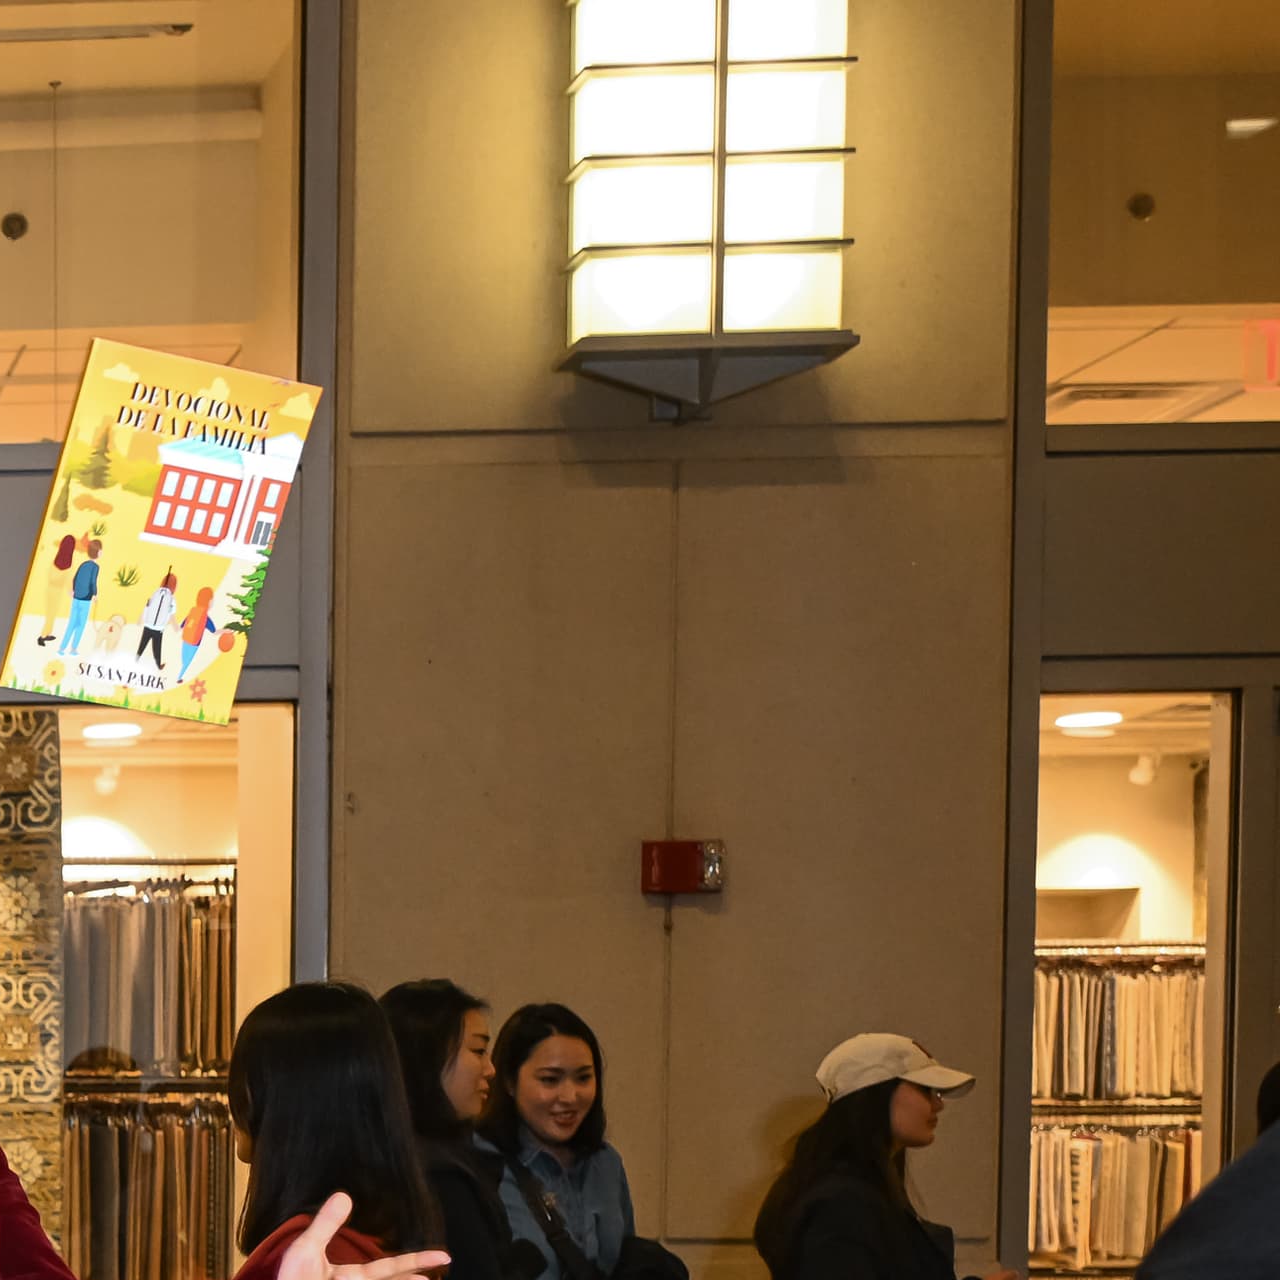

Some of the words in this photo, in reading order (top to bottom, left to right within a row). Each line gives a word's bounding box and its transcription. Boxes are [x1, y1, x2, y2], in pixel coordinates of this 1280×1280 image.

[129, 381, 270, 430] DEVOCIONAL
[116, 405, 145, 428] DE
[152, 415, 181, 435] LA
[183, 422, 268, 456] FAMILIA
[78, 661, 123, 683] SUSAN
[126, 669, 168, 691] PARK
